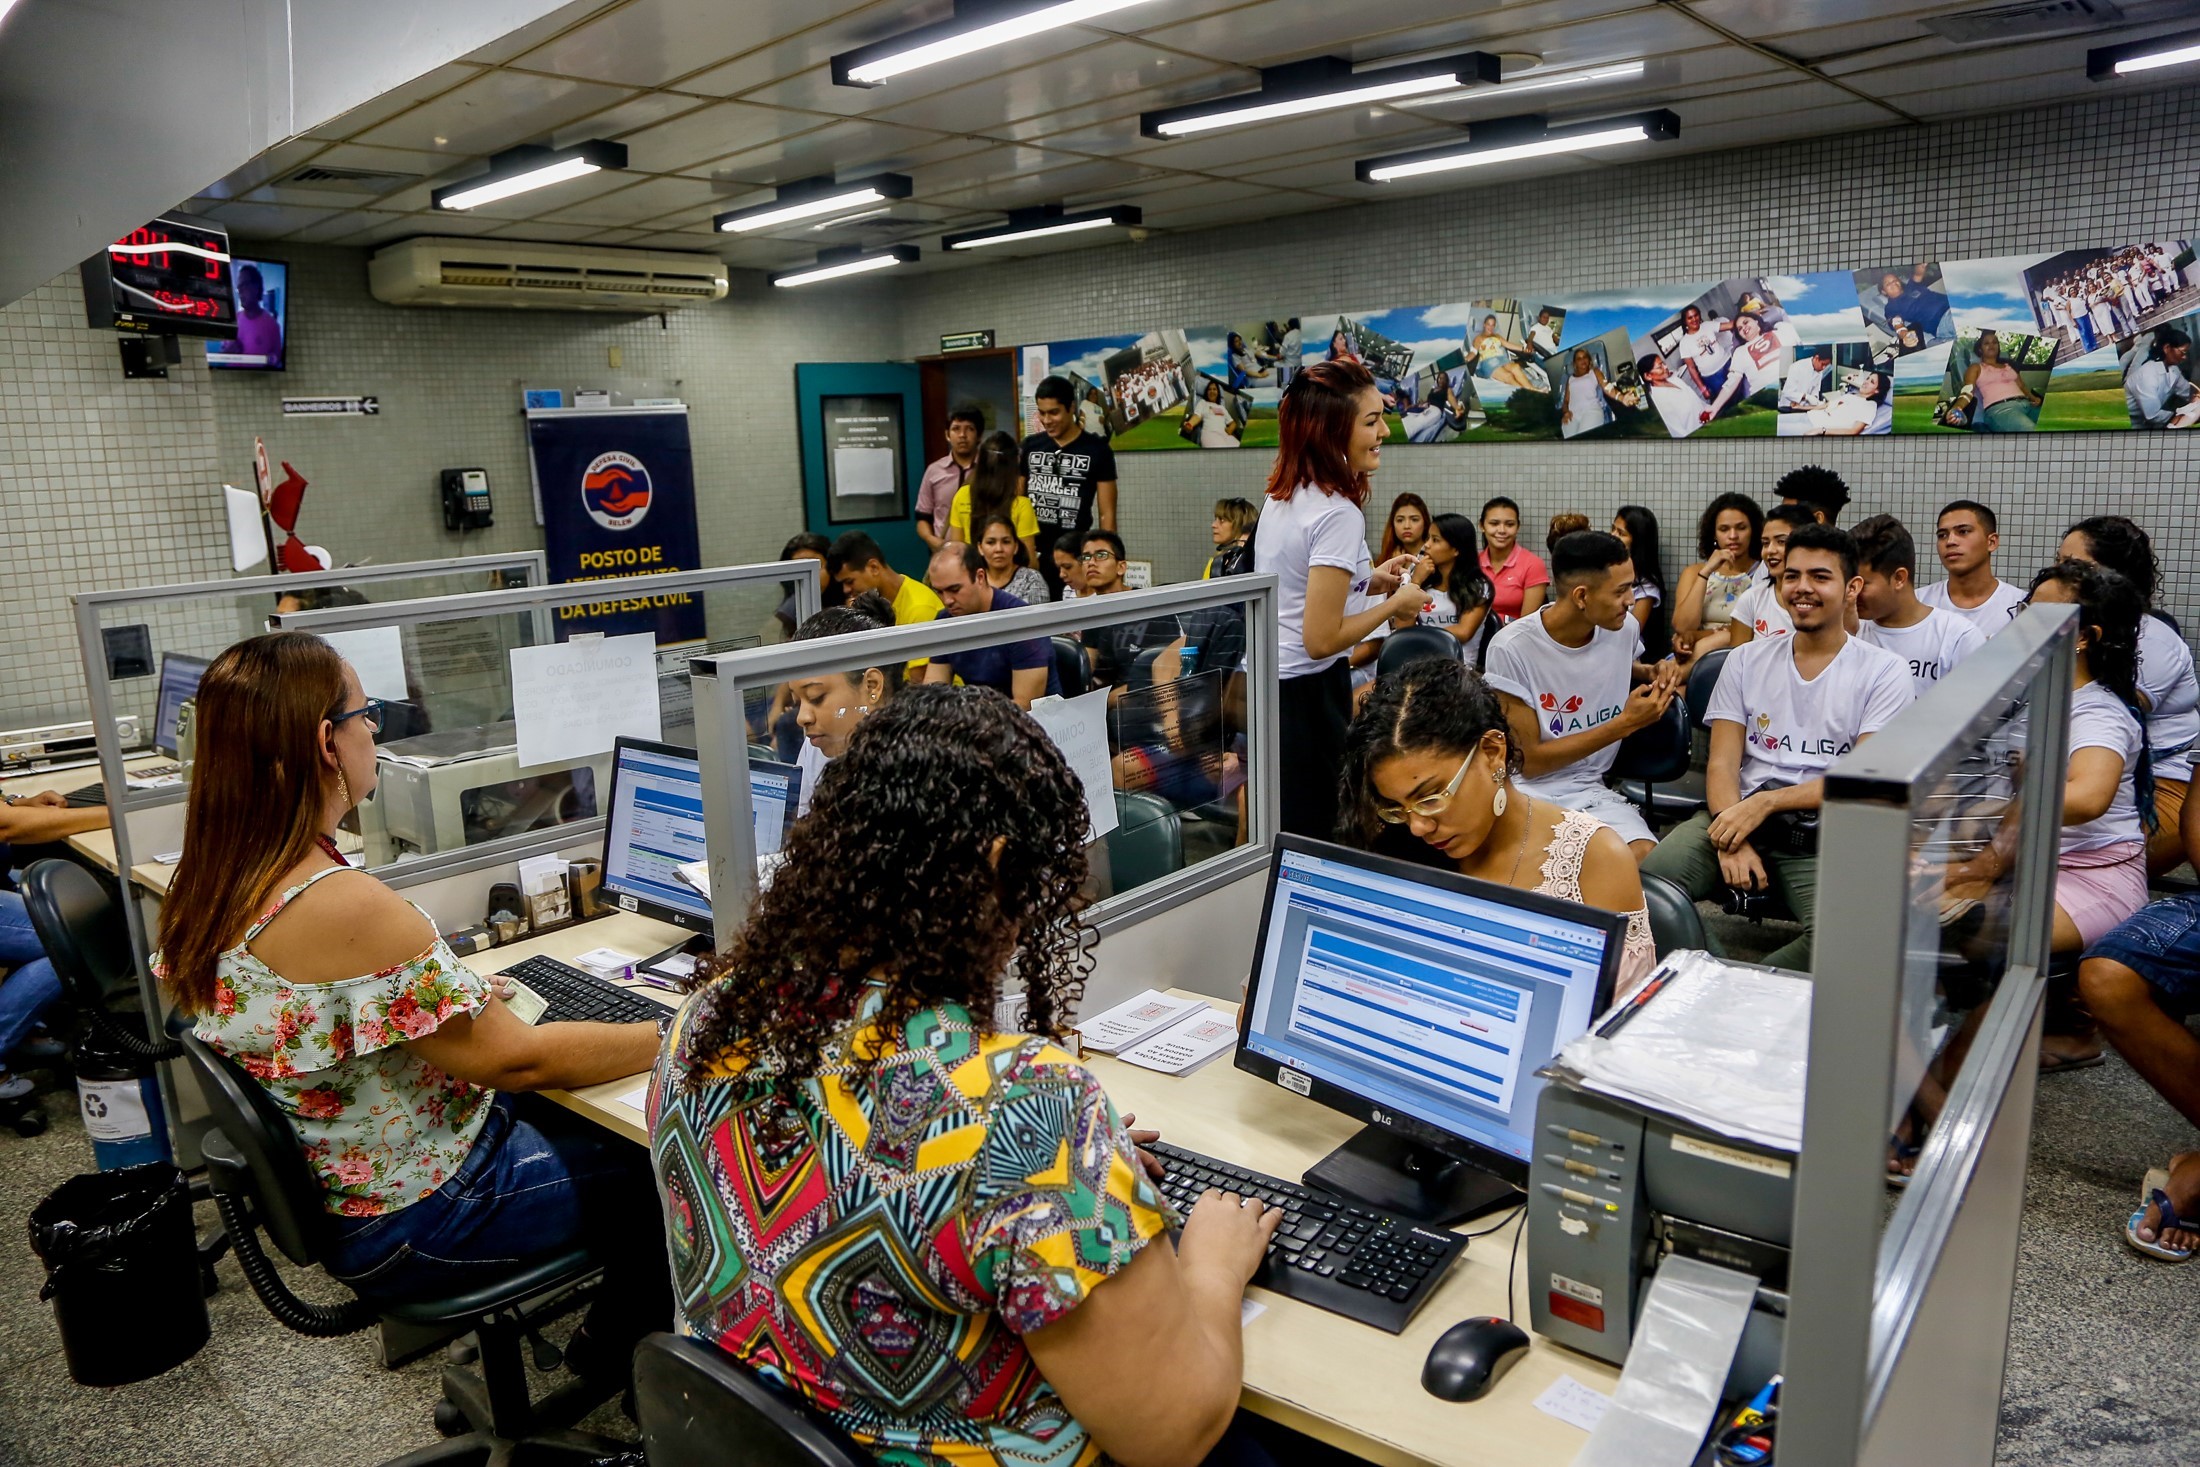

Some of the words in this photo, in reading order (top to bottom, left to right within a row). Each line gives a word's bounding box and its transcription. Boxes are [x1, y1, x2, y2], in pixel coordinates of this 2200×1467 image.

[579, 548, 637, 569] POSTO
[640, 546, 663, 564] DE
[560, 603, 586, 620] DA
[589, 596, 652, 617] DEFESA
[653, 592, 692, 608] CIVIL
[1438, 615, 1459, 624] LIG
[1568, 718, 1582, 731] A
[1586, 705, 1622, 727] LIGA
[1778, 735, 1792, 752] A
[1801, 739, 1851, 757] LIGA
[1164, 1047, 1193, 1058] DOADOR
[1166, 1042, 1195, 1053] SANGUE
[1134, 1051, 1183, 1067] ORIENTAÇÕES
[1158, 1051, 1184, 1062] GERAIS
[1381, 1114, 1392, 1126] LG
[1410, 1226, 1452, 1243] lenovo
